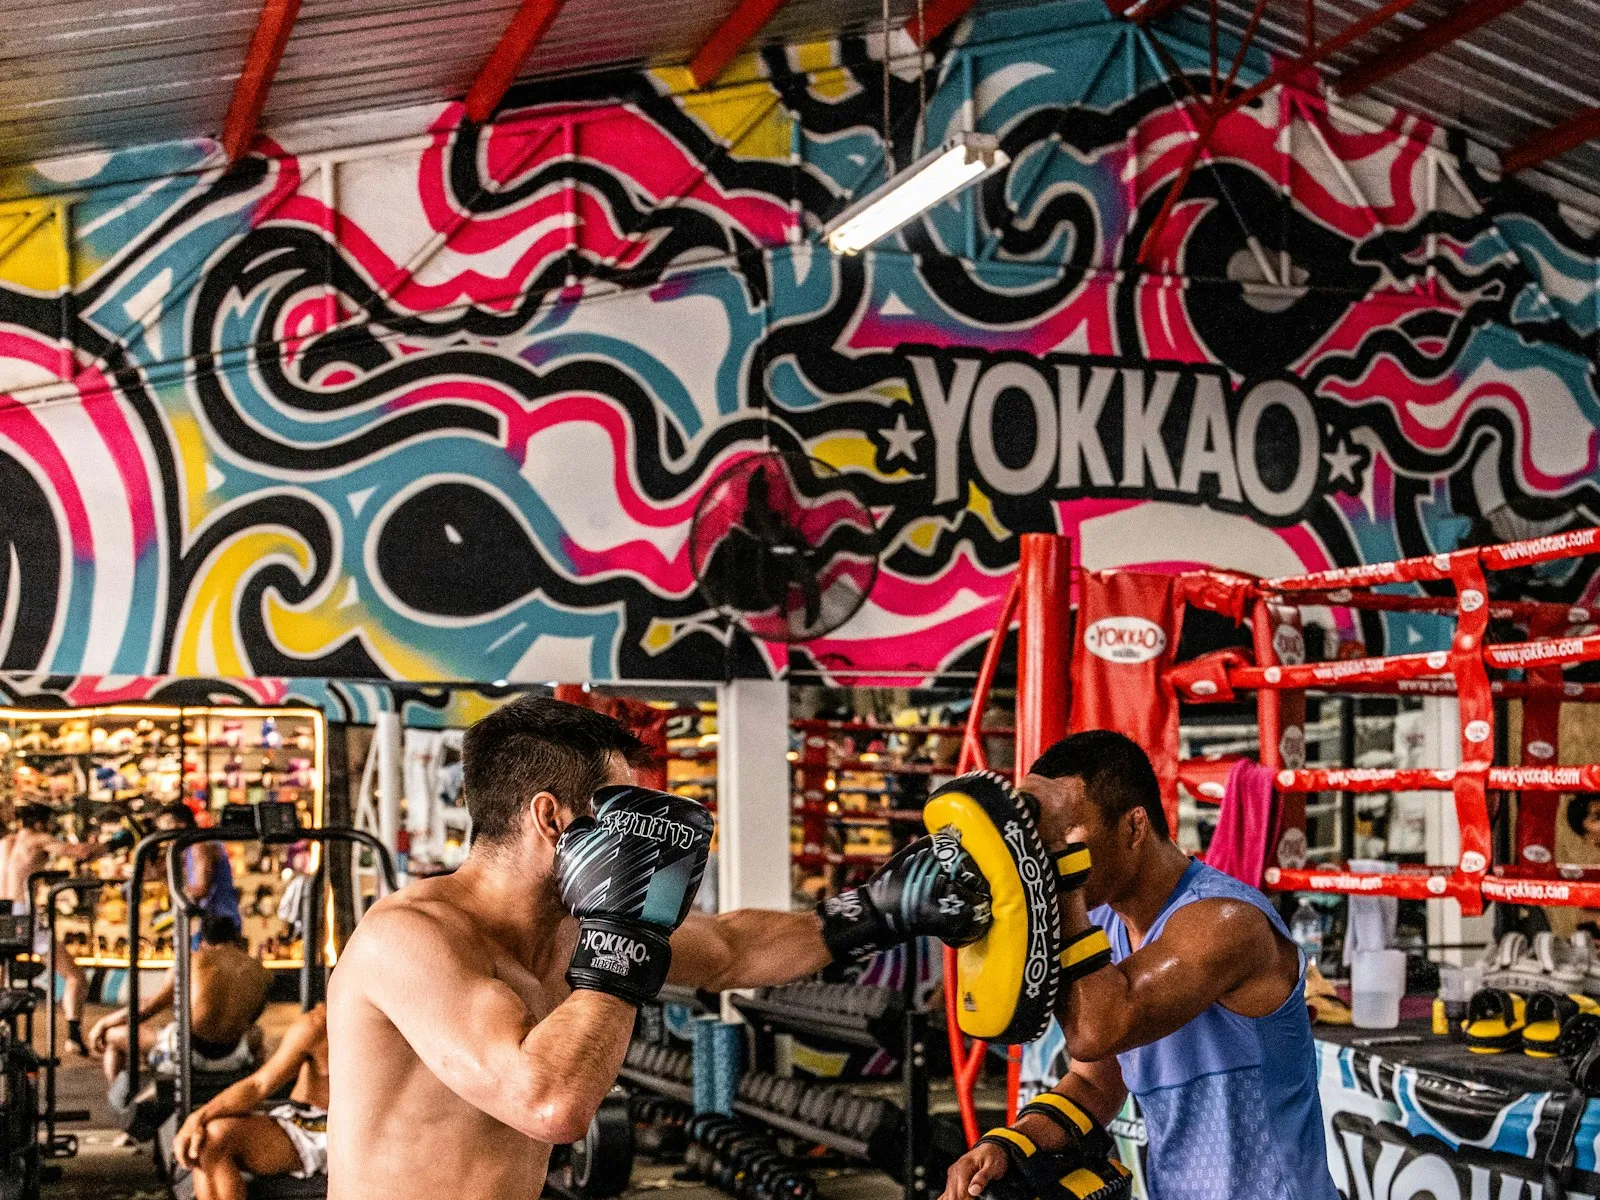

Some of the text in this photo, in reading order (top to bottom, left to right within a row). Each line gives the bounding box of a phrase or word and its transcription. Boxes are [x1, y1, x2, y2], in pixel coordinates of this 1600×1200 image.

[905, 354, 1321, 517] YOKKAO
[584, 929, 647, 963] YOKKAO
[1004, 830, 1049, 987] YOKKAO
